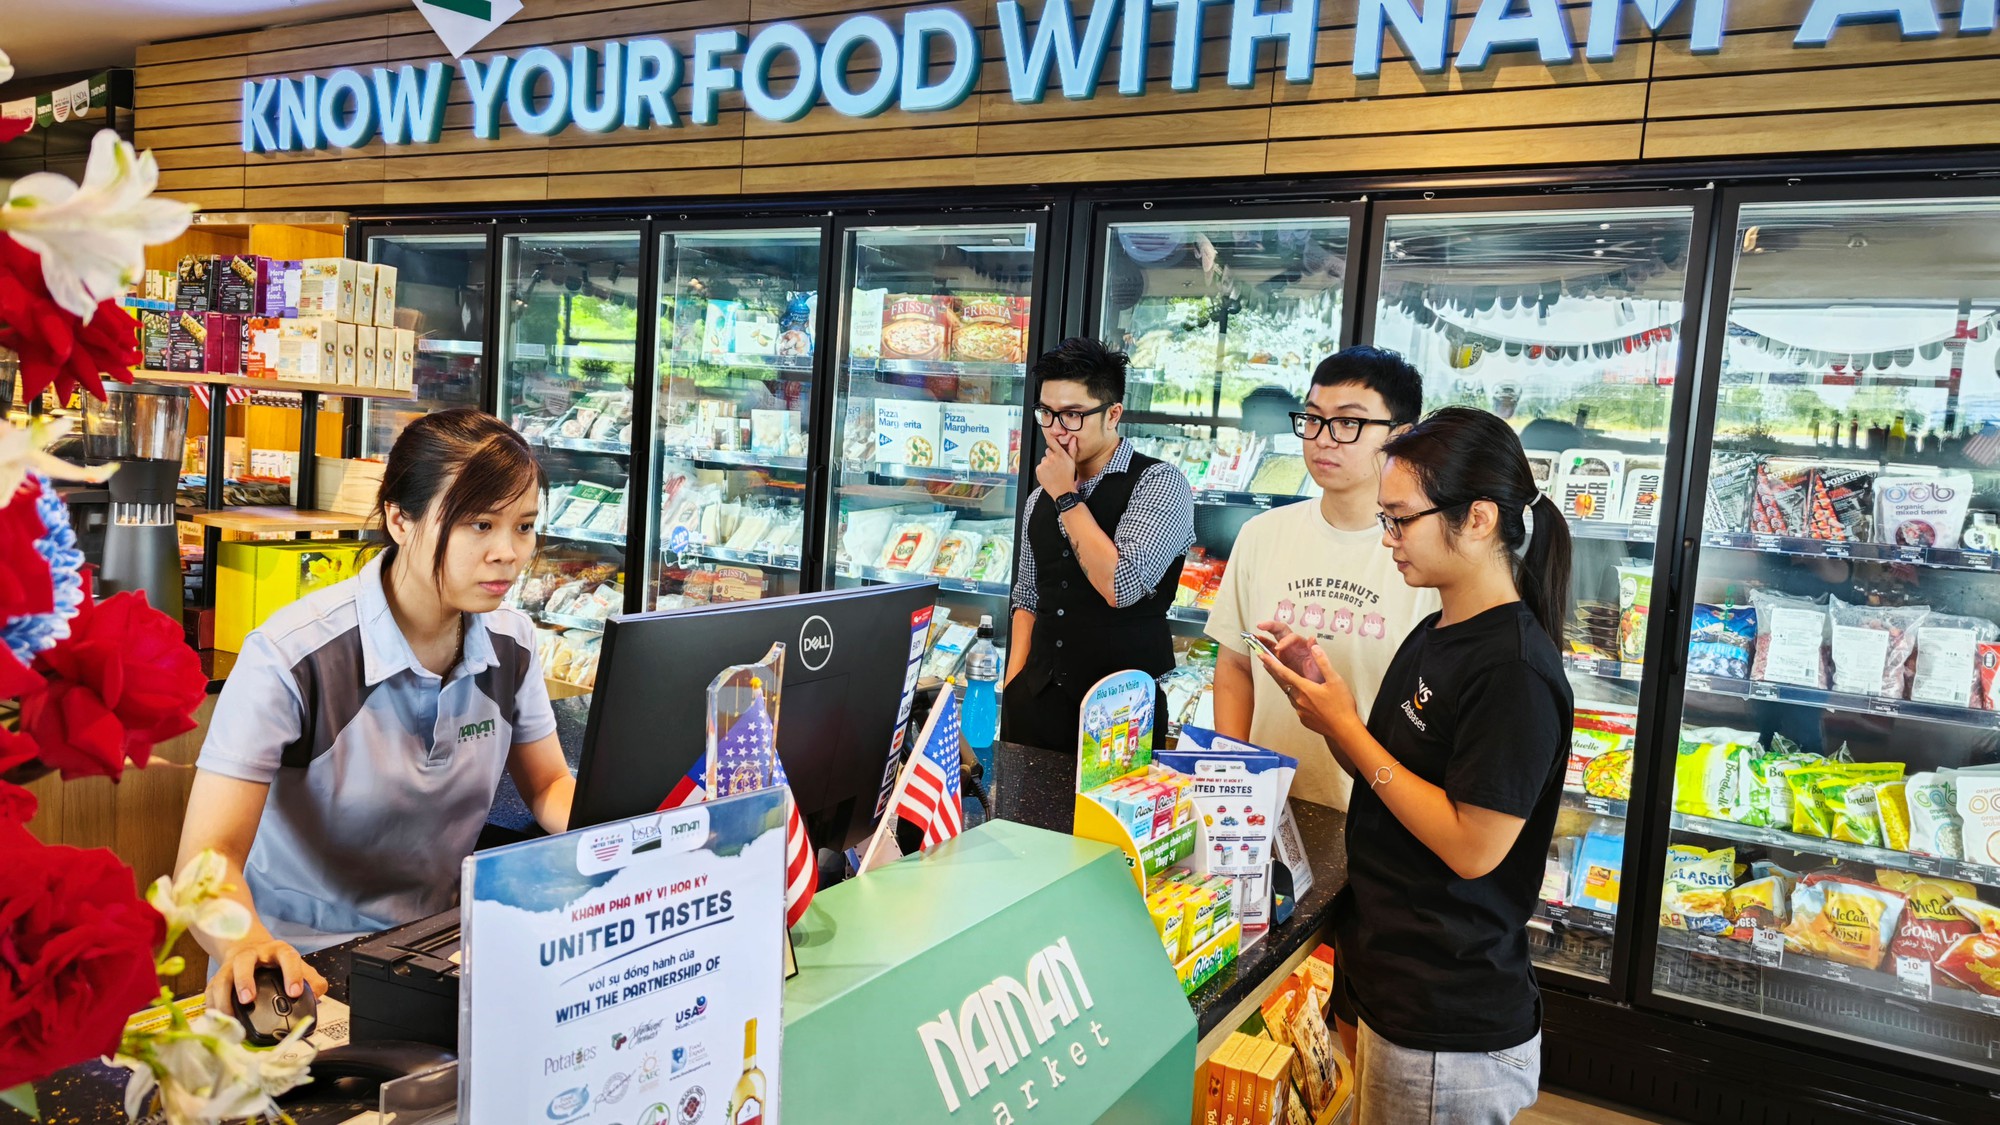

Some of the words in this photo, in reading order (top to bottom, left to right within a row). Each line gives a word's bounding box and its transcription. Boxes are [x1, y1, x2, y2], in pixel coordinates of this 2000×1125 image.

[242, 61, 450, 153] KNOW
[461, 38, 681, 139] YOUR
[693, 14, 981, 124] FOOD
[997, 0, 1318, 103] WITH
[1352, 0, 1722, 78] NAM
[890, 301, 936, 317] FRISSTA
[963, 305, 1012, 320] FRISSTA
[878, 408, 898, 419] Pizza
[944, 412, 966, 423] Pizza
[878, 418, 922, 431] Margerita
[944, 422, 990, 434] Margherita
[719, 570, 748, 580] FRISSTA
[1288, 582, 1292, 591] I
[1295, 577, 1322, 589] LIKE
[1326, 578, 1380, 604] PEANUTS
[1304, 589, 1326, 598] HATE
[1328, 591, 1364, 608] CARROTS
[804, 634, 830, 650] DELL
[1571, 739, 1599, 751] duelle
[1195, 785, 1215, 793] ITED
[1219, 785, 1253, 794] TASTES
[1135, 803, 1154, 819] Ricola
[632, 825, 662, 841] USDA
[1670, 868, 1733, 886] CLASSIC
[670, 880, 691, 895] HOA
[1196, 903, 1214, 920] Ricola
[1830, 905, 1869, 924] McCain
[540, 918, 635, 966] UNITED
[645, 889, 732, 934] TASTES
[1165, 915, 1182, 931] Ricola
[653, 955, 676, 972] hành
[679, 947, 695, 962] của
[1191, 947, 1223, 985] Ricola
[556, 1000, 590, 1023] WITH
[595, 990, 618, 1010] THE
[623, 962, 702, 1000] PARTNERSHIP
[705, 956, 720, 972] OF
[675, 1005, 699, 1023] USA
[917, 936, 1094, 1113] NAMAN
[992, 1020, 1110, 1125] arket
[1243, 1098, 1251, 1106] 15
